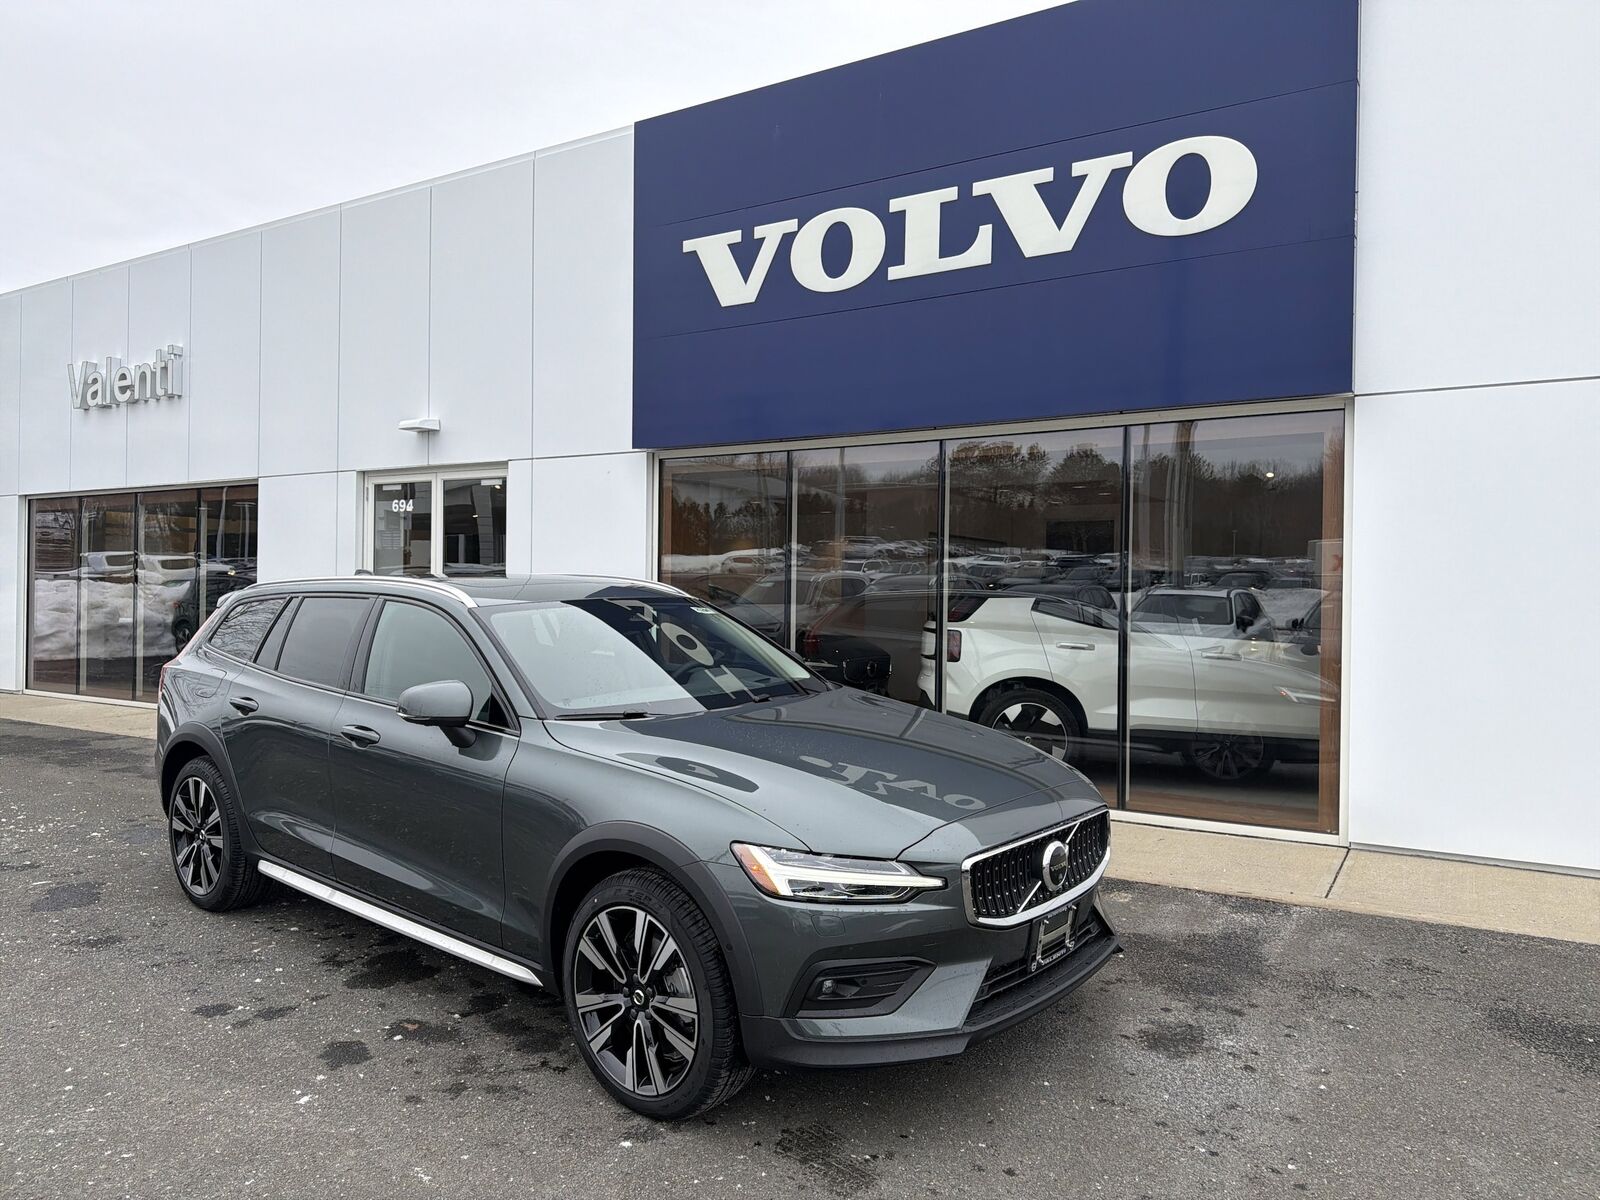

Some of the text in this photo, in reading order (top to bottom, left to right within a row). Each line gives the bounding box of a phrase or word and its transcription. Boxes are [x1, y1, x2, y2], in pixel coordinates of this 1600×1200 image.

[683, 135, 1258, 308] VOLVO
[67, 344, 182, 409] Valenti
[392, 499, 414, 512] 694
